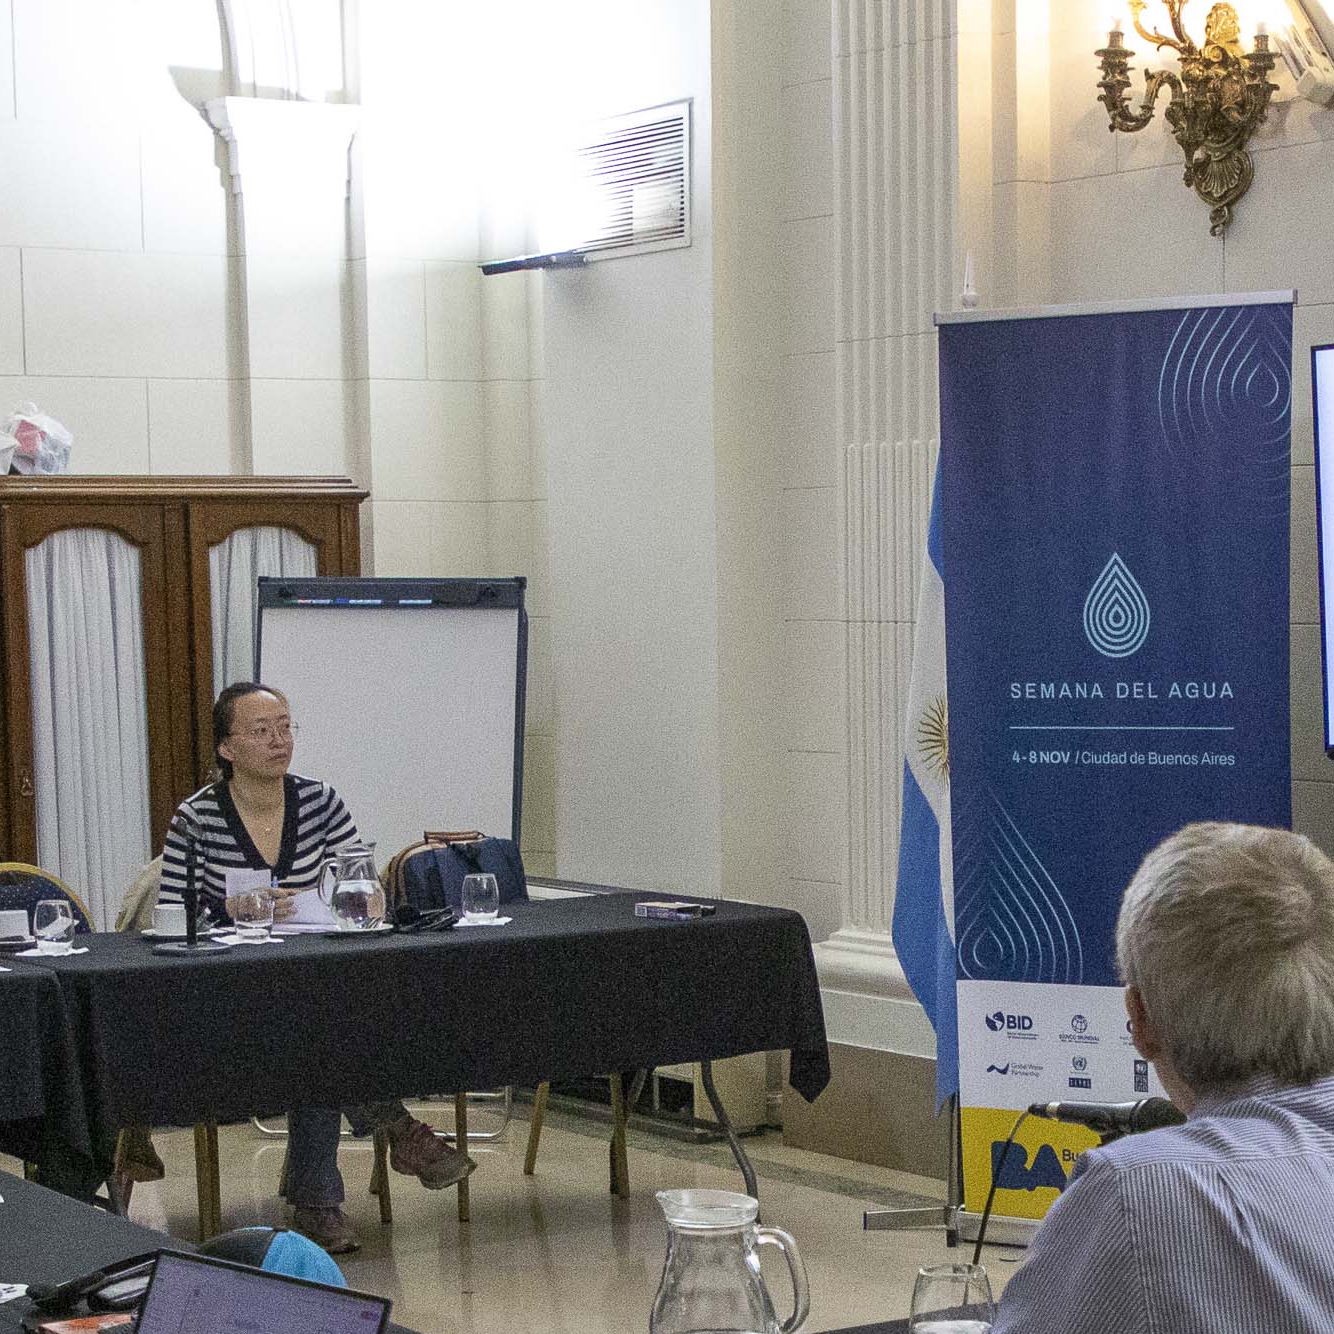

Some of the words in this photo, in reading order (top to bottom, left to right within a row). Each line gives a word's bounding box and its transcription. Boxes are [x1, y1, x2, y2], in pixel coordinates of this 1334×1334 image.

[1010, 682, 1104, 699] SEMANA
[1116, 682, 1159, 698] DEL
[1168, 682, 1234, 699] AGUA
[1039, 751, 1070, 764] NOV
[1129, 751, 1146, 765] de
[1148, 752, 1198, 765] Buenos
[1201, 752, 1235, 766] Aires
[1007, 1014, 1033, 1030] BID
